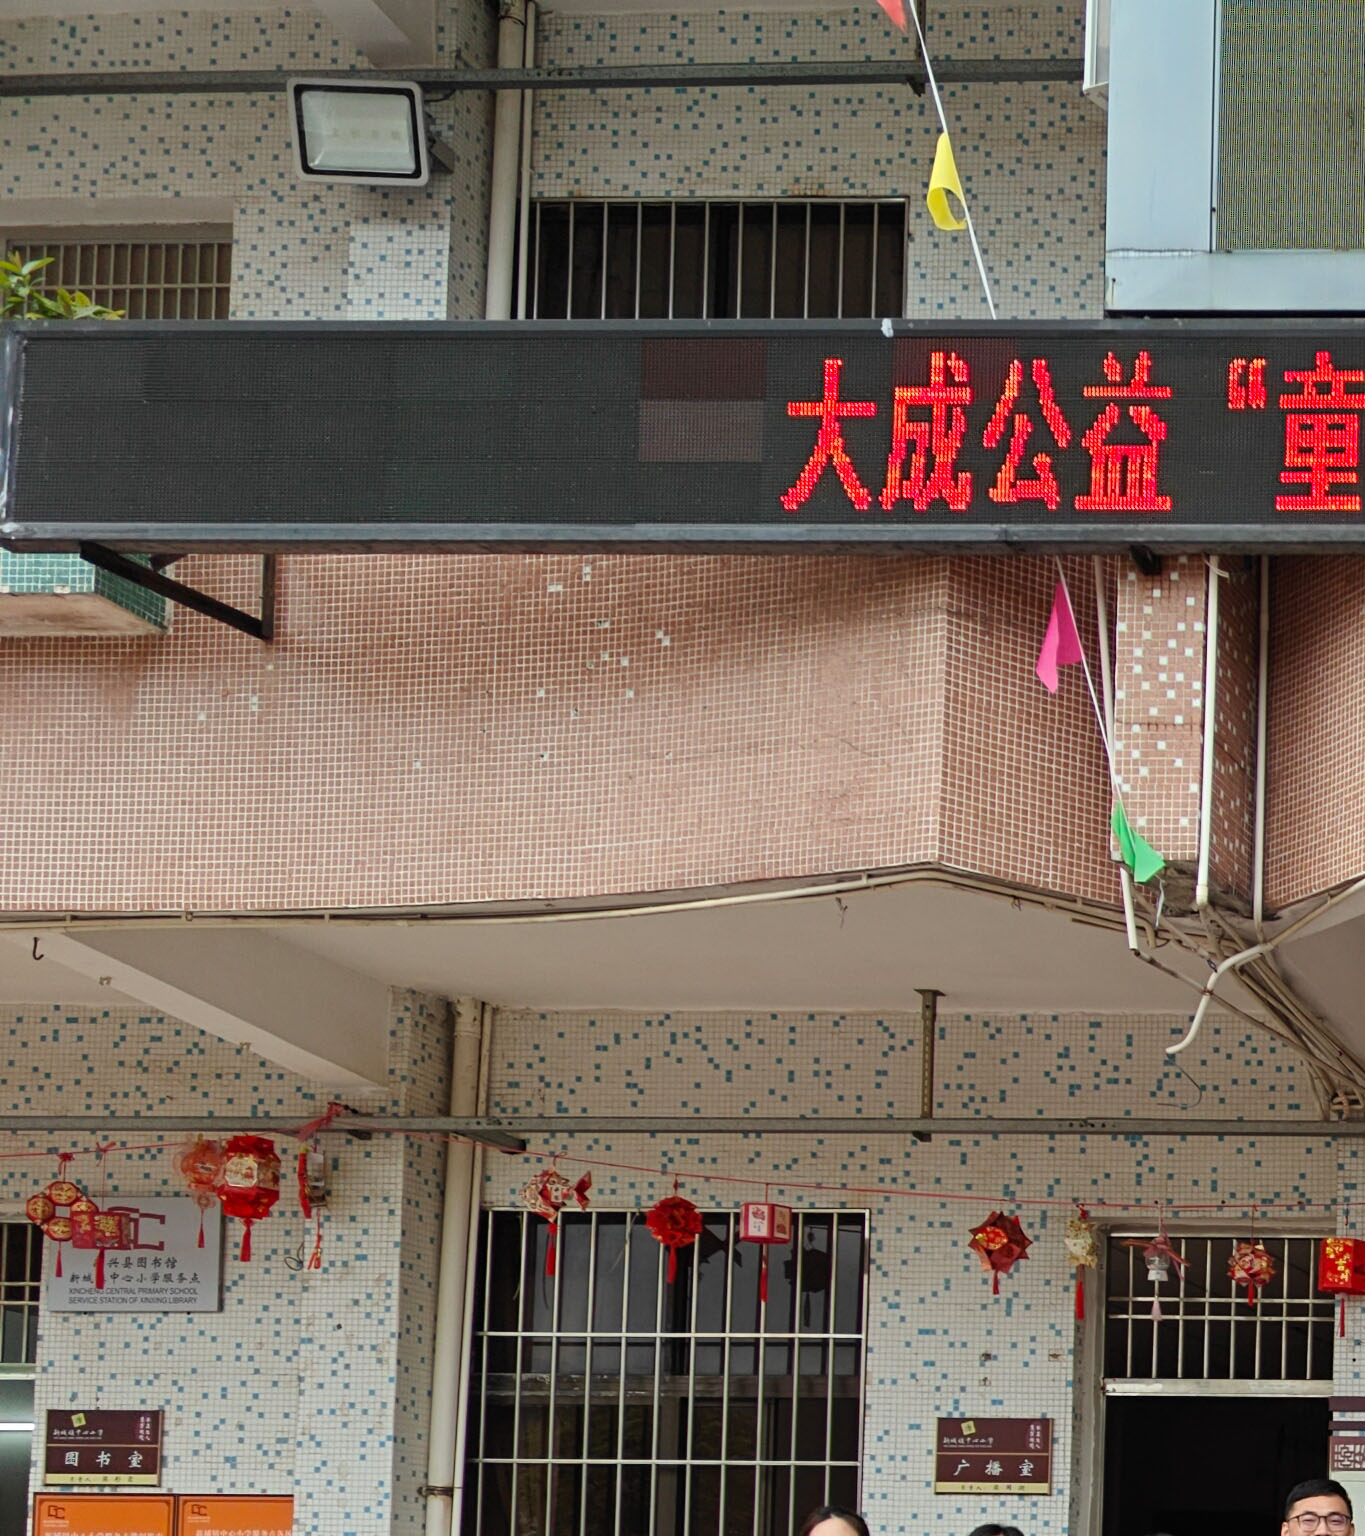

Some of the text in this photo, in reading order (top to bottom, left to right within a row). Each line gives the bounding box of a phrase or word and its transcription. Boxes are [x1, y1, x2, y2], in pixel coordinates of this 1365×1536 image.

[781, 352, 1171, 510] 大成公益
[93, 1256, 178, 1269] 兴县图书馆
[69, 1272, 201, 1284] 新城中心小学服务点
[64, 1450, 143, 1468] 图书室
[953, 1459, 1034, 1477] 广播室
